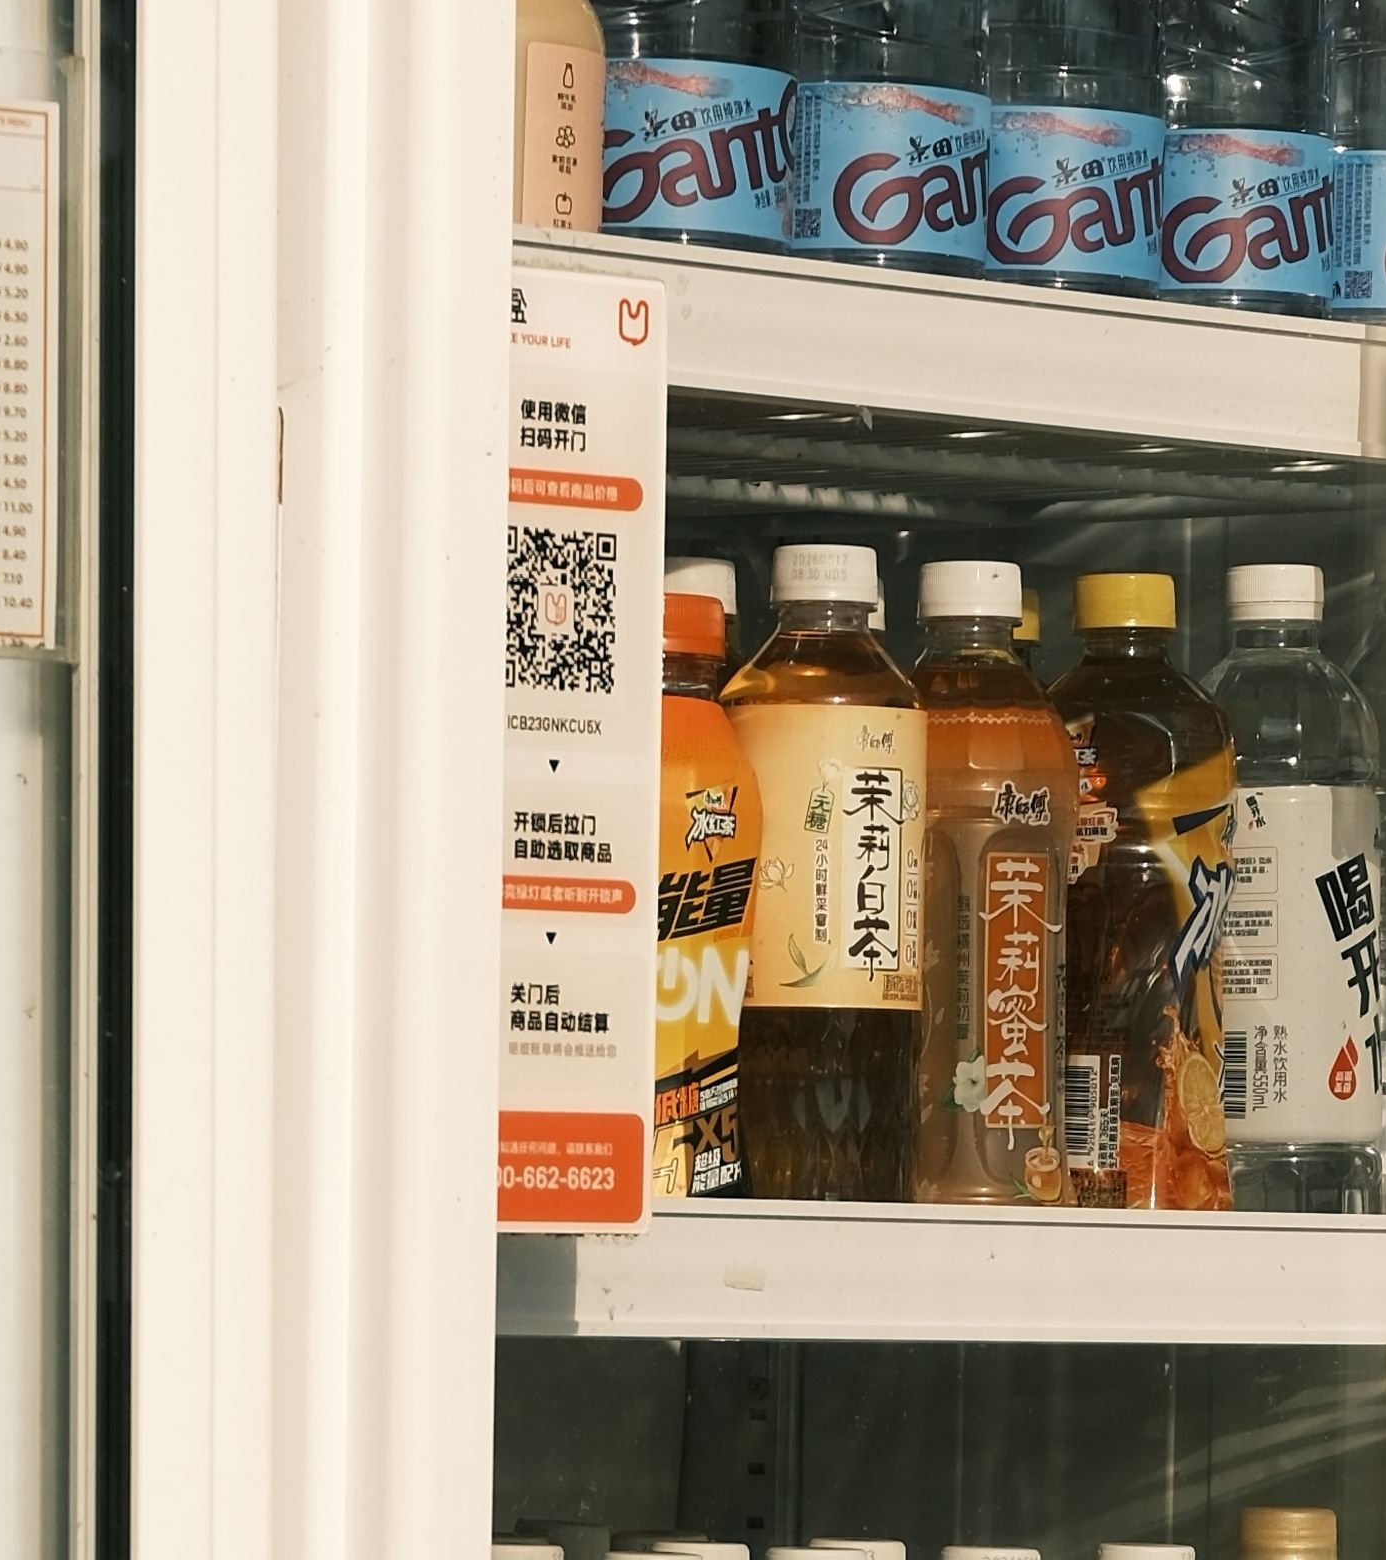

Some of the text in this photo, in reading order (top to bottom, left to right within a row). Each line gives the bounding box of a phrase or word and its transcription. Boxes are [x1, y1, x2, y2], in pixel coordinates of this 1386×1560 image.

[699, 98, 753, 125] 饮用纯净水
[603, 79, 798, 222] Gant
[521, 333, 571, 349] YOUR LIFE
[521, 399, 587, 426] 使用微信
[521, 427, 586, 452] 扫码开门
[993, 780, 1051, 827] 康师傅
[514, 811, 596, 836] 开锁后拉门
[688, 809, 737, 848] 冰红茶
[514, 838, 612, 863] 自助选取商品
[842, 771, 904, 981] 茉莉白茶
[657, 857, 757, 940] 能量
[511, 983, 560, 1005] 关门后
[979, 856, 1062, 1150] 茉莉蜜茶
[510, 1010, 610, 1034] 商品自动结算
[1273, 1024, 1289, 1104] 熟水饮用水
